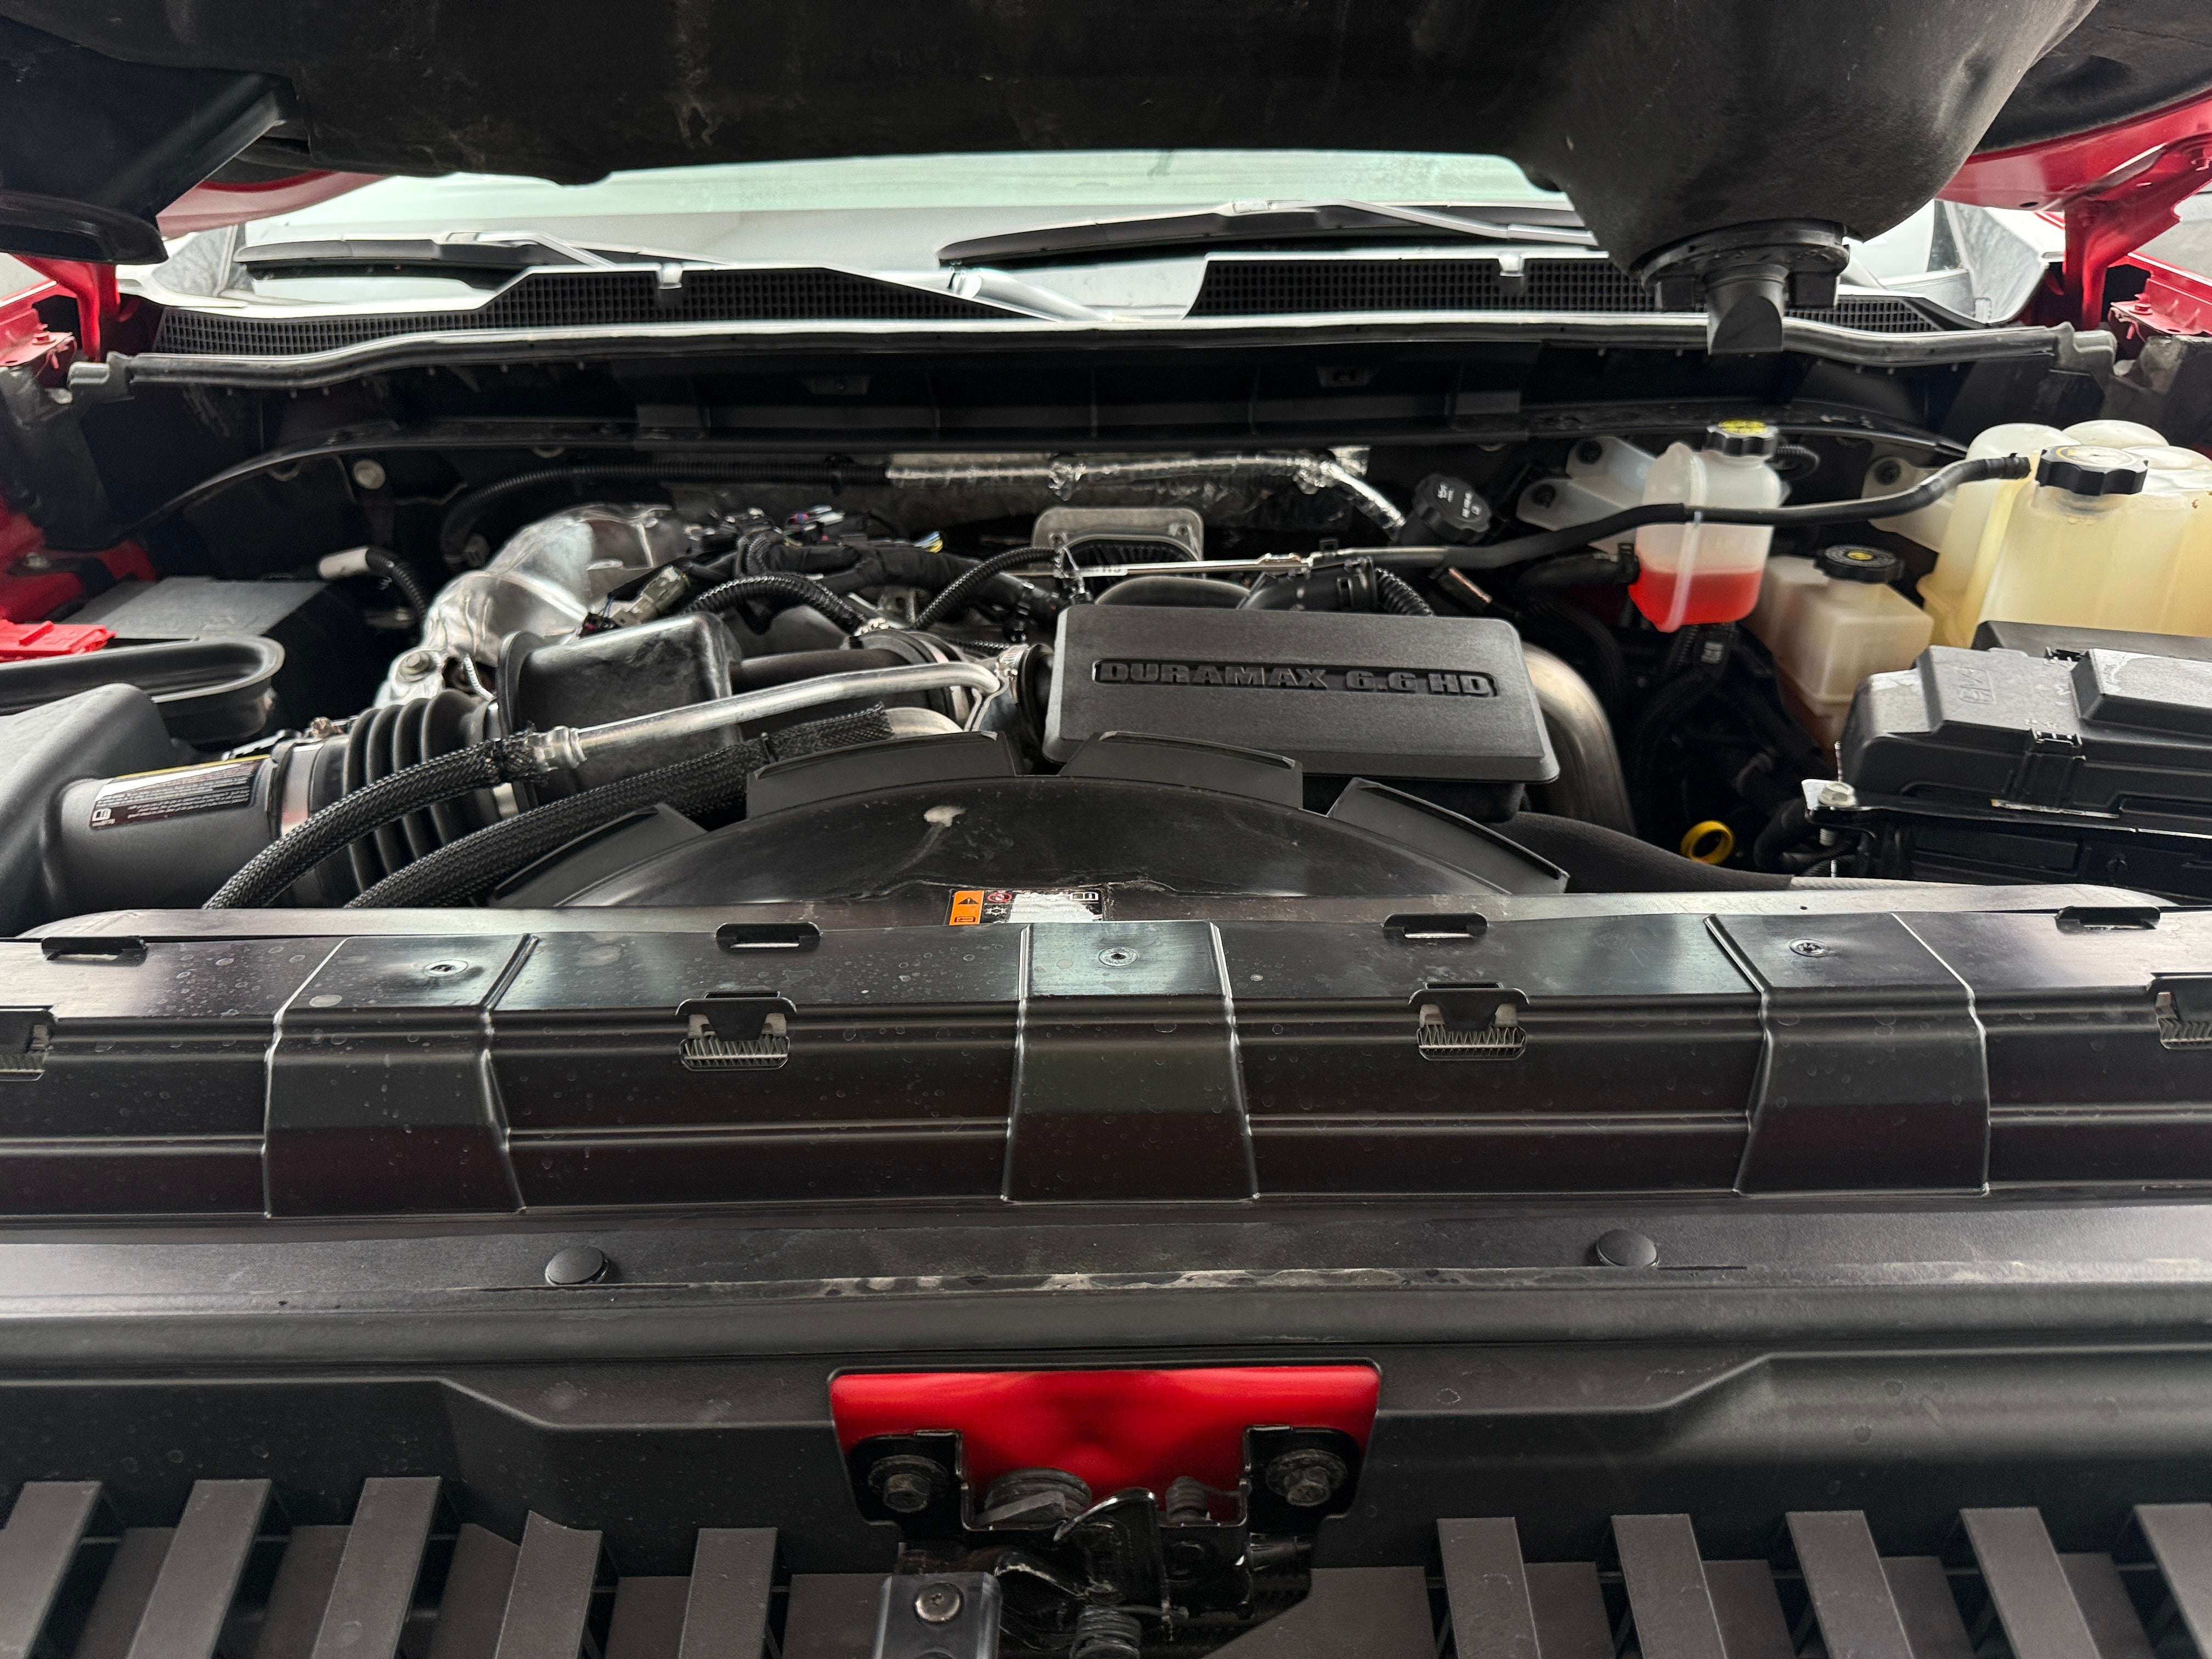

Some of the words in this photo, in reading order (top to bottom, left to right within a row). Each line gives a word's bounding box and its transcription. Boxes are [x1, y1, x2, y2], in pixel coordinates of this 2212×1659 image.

[1099, 663, 1327, 688] DURAMAX
[1346, 669, 1417, 692] 6.6
[1427, 673, 1490, 695] HD
